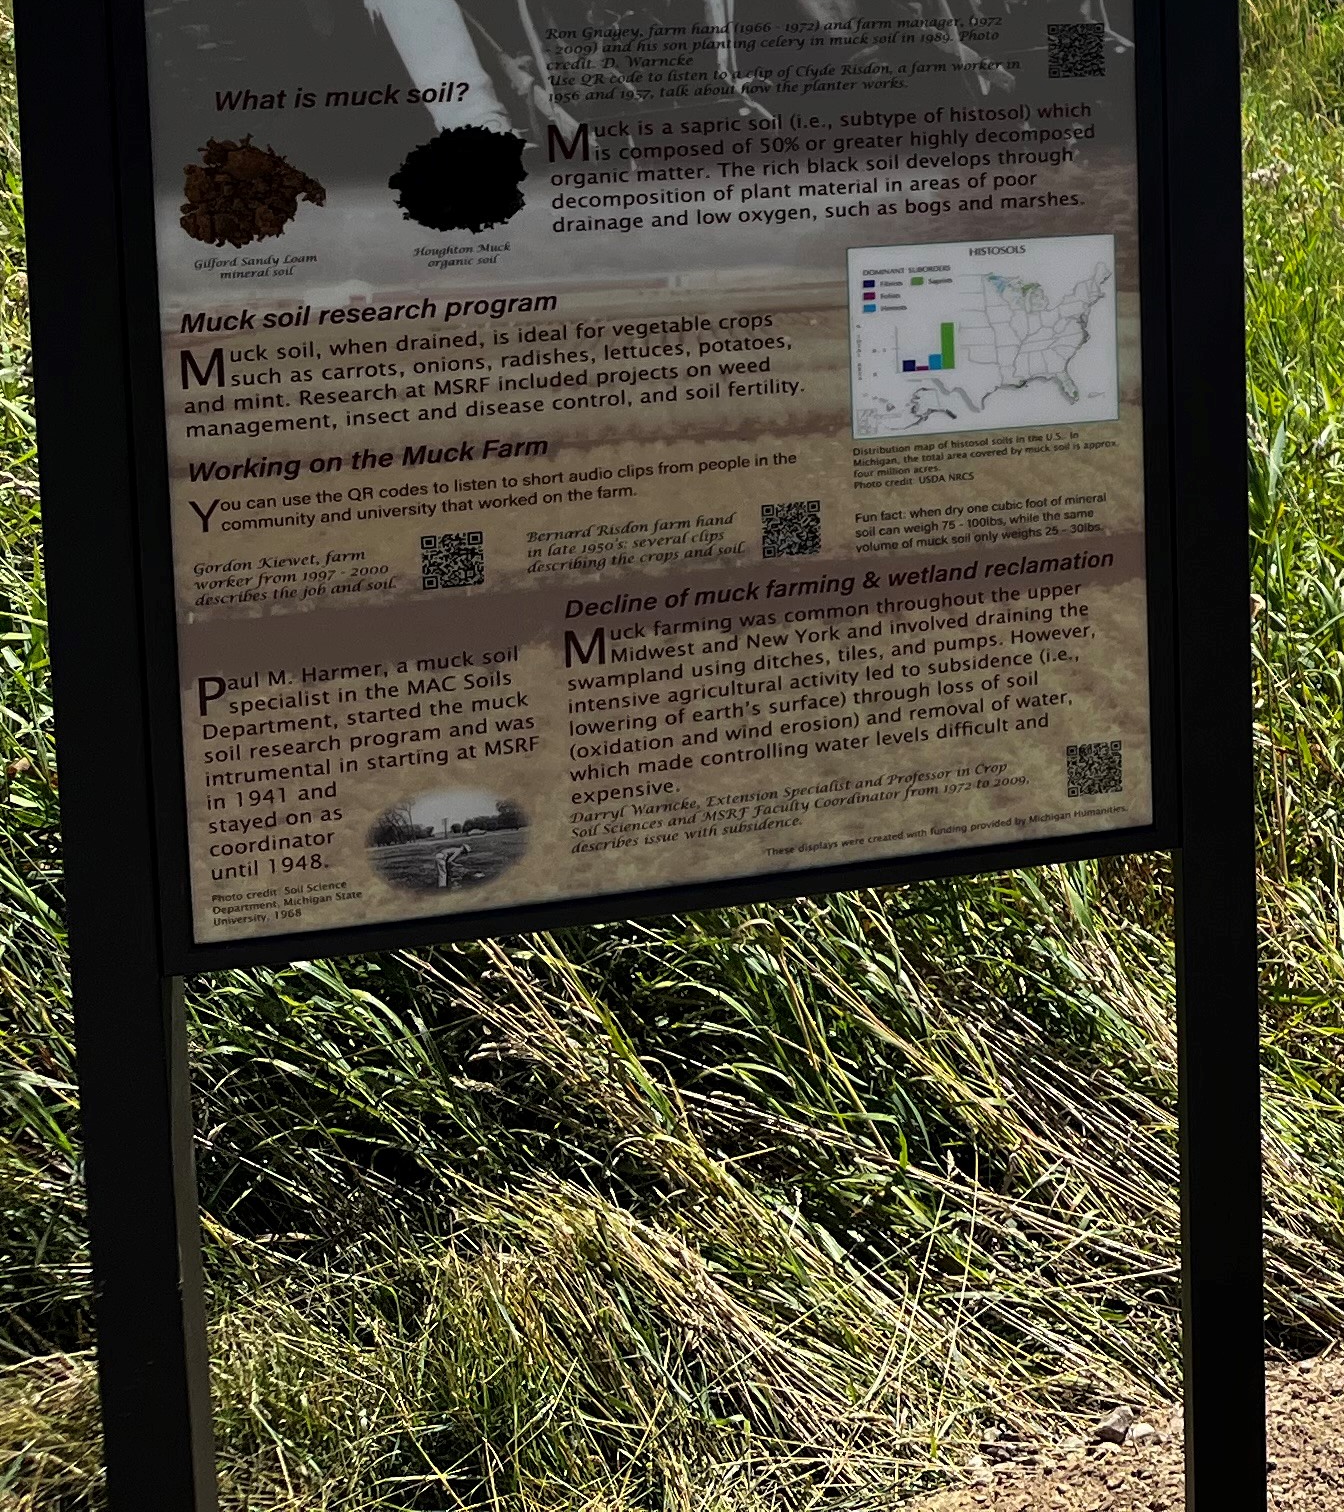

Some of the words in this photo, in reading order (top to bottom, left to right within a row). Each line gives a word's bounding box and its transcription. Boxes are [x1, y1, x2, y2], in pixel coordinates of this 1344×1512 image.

[215, 86, 287, 111] What
[293, 86, 316, 108] is
[324, 82, 399, 107] muck
[406, 80, 469, 104] soil?
[552, 211, 644, 235] drainage
[650, 206, 688, 228] and
[696, 205, 732, 226] low
[737, 205, 817, 227] oxygen,
[824, 197, 870, 219] such
[876, 201, 898, 216] as
[904, 195, 951, 219] bogs
[958, 191, 993, 212] and
[1000, 188, 1085, 210] marshes.
[412, 241, 473, 258] Houghton
[477, 239, 511, 253] Muck
[426, 254, 473, 271] organic
[476, 252, 497, 266] soil
[968, 243, 1026, 257] HISTOSOLS
[219, 266, 269, 280] mineral
[272, 265, 293, 278] soil
[180, 307, 255, 334] Muck
[262, 304, 310, 329] soil
[318, 296, 436, 325] research
[444, 293, 557, 322] program
[188, 455, 301, 482] Working
[308, 455, 342, 474] on
[350, 447, 394, 470] the
[401, 440, 474, 467] Muck
[481, 438, 548, 461] Farm
[564, 592, 658, 620] Decline
[664, 586, 688, 610] of
[694, 579, 759, 607] muck
[765, 572, 855, 600] farming
[862, 567, 880, 591] &
[888, 557, 978, 588] wetland
[984, 547, 1114, 579] reclamation
[210, 858, 258, 881] until
[270, 852, 329, 875] 1948.
